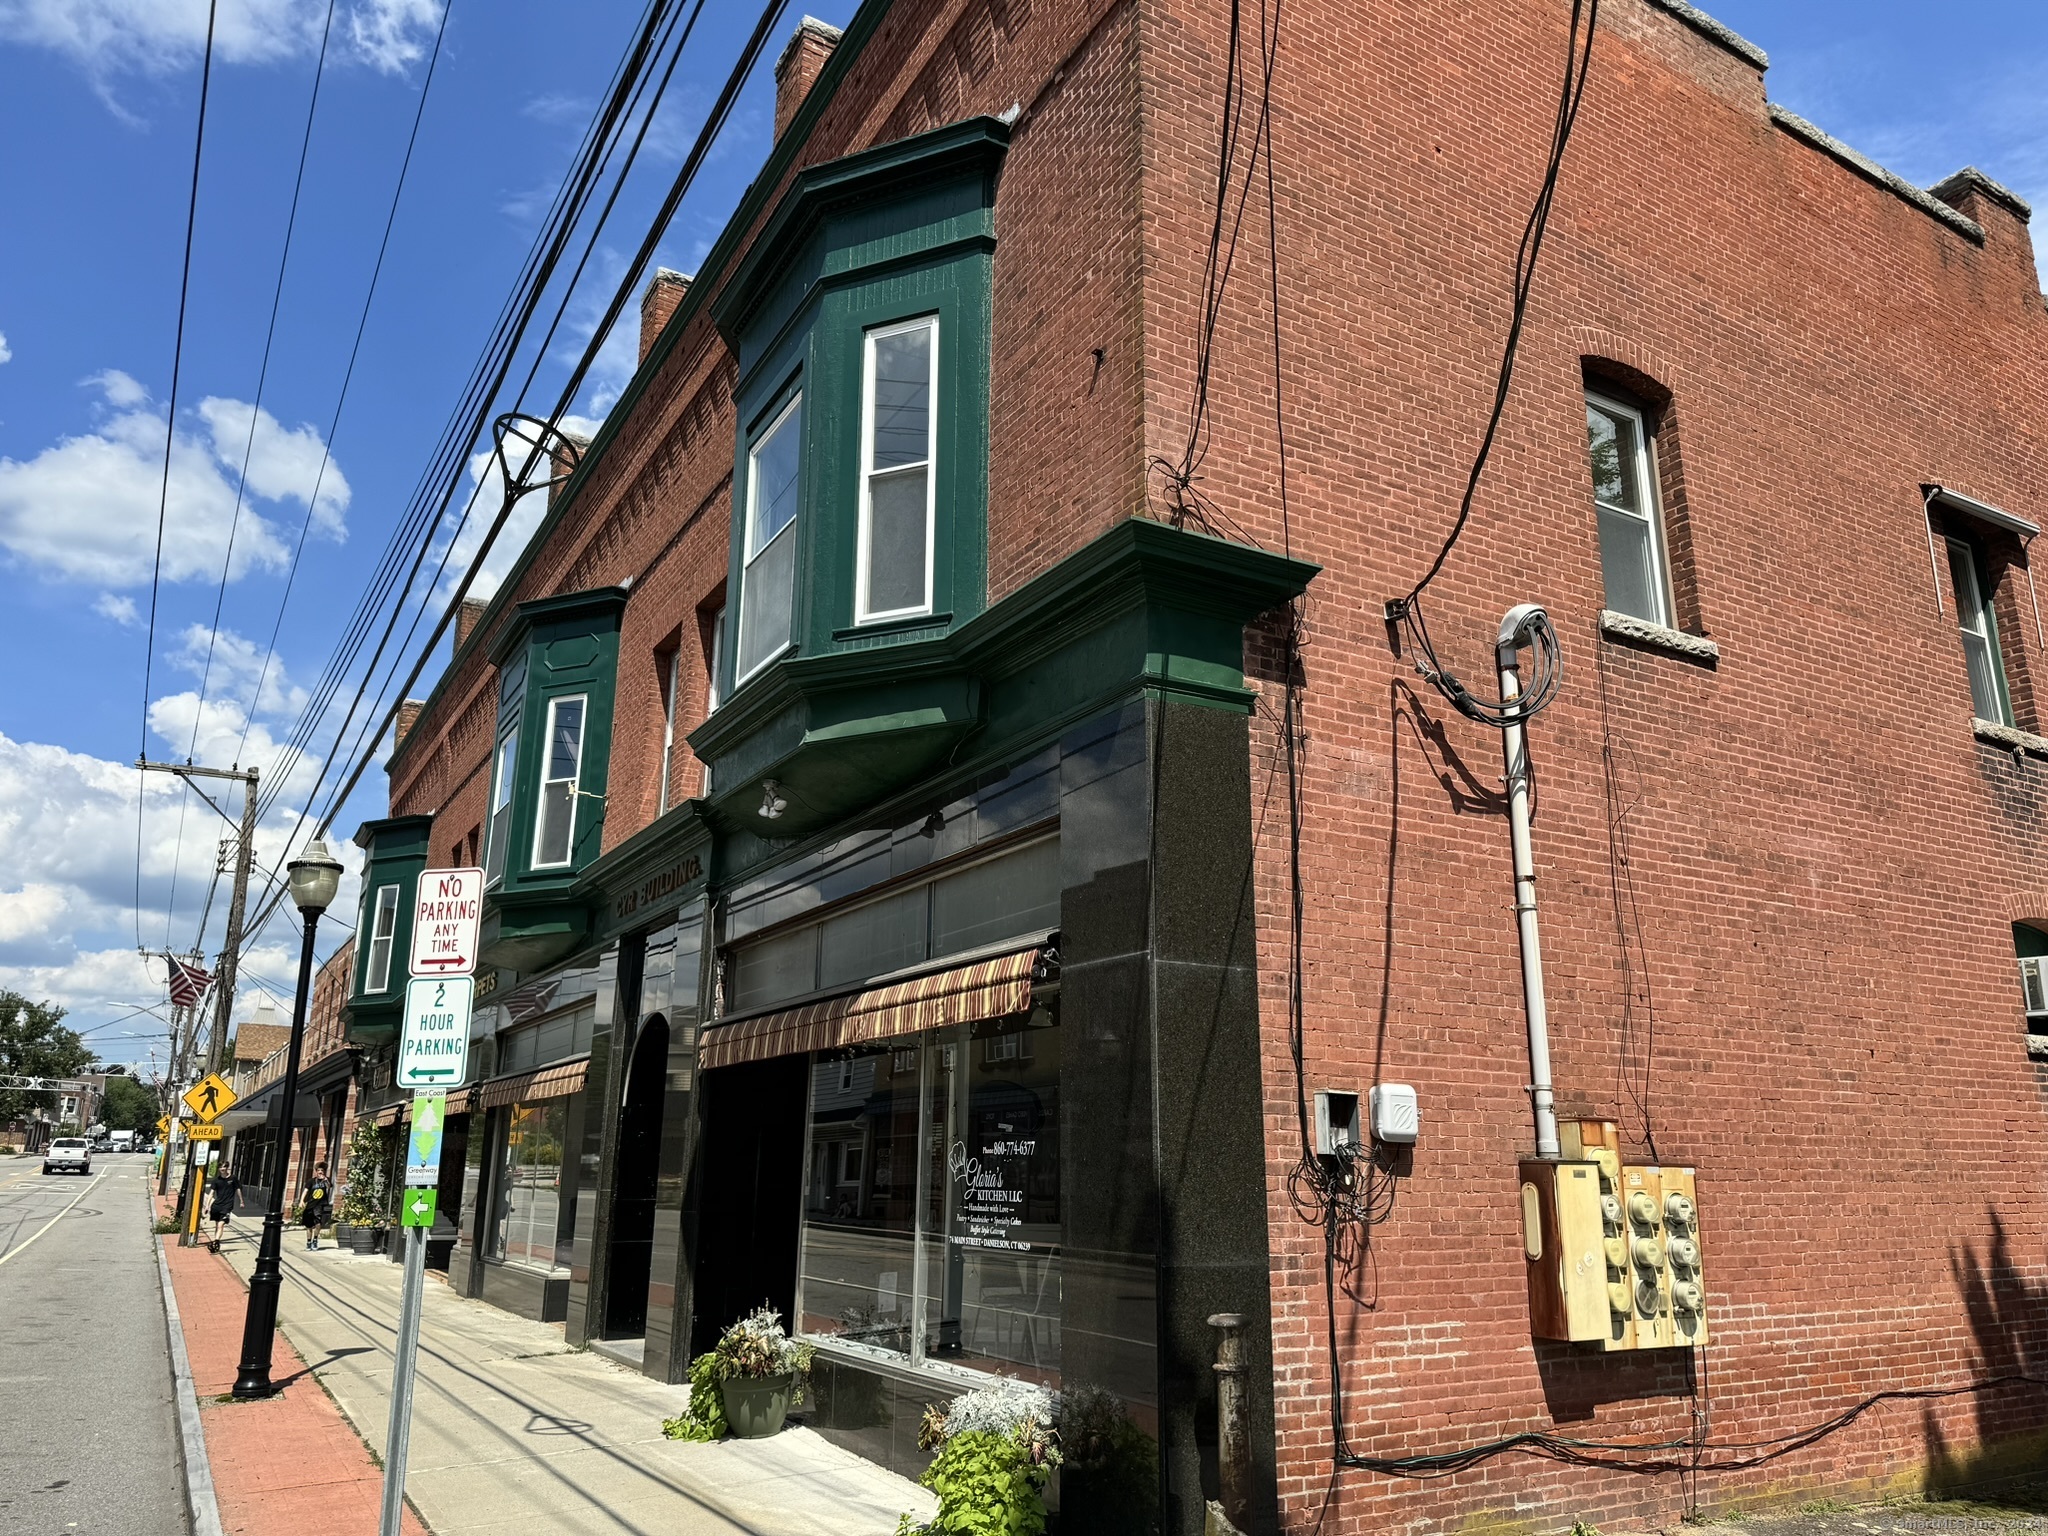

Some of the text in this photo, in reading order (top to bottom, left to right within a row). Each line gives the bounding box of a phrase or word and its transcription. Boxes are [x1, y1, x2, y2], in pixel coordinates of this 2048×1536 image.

[438, 878, 462, 898] NO
[419, 900, 476, 921] PARKING
[433, 923, 459, 937] ANY
[431, 939, 459, 953] TIME
[434, 987, 446, 1007] 2
[420, 1013, 454, 1031] HOUR
[406, 1038, 462, 1056] PARKING
[415, 1089, 445, 1097] East Coast
[192, 1128, 219, 1136] AHEAD
[993, 1140, 1036, 1156] 860-774-6377
[408, 1166, 437, 1174] Greenway
[964, 1157, 1004, 1200] Gloria's
[977, 1189, 1023, 1203] KITCHEN LLC
[968, 1203, 989, 1212] Handmade
[999, 1204, 1009, 1213] Love
[965, 1237, 982, 1246] STREET
[1010, 1240, 1018, 1250] CT
